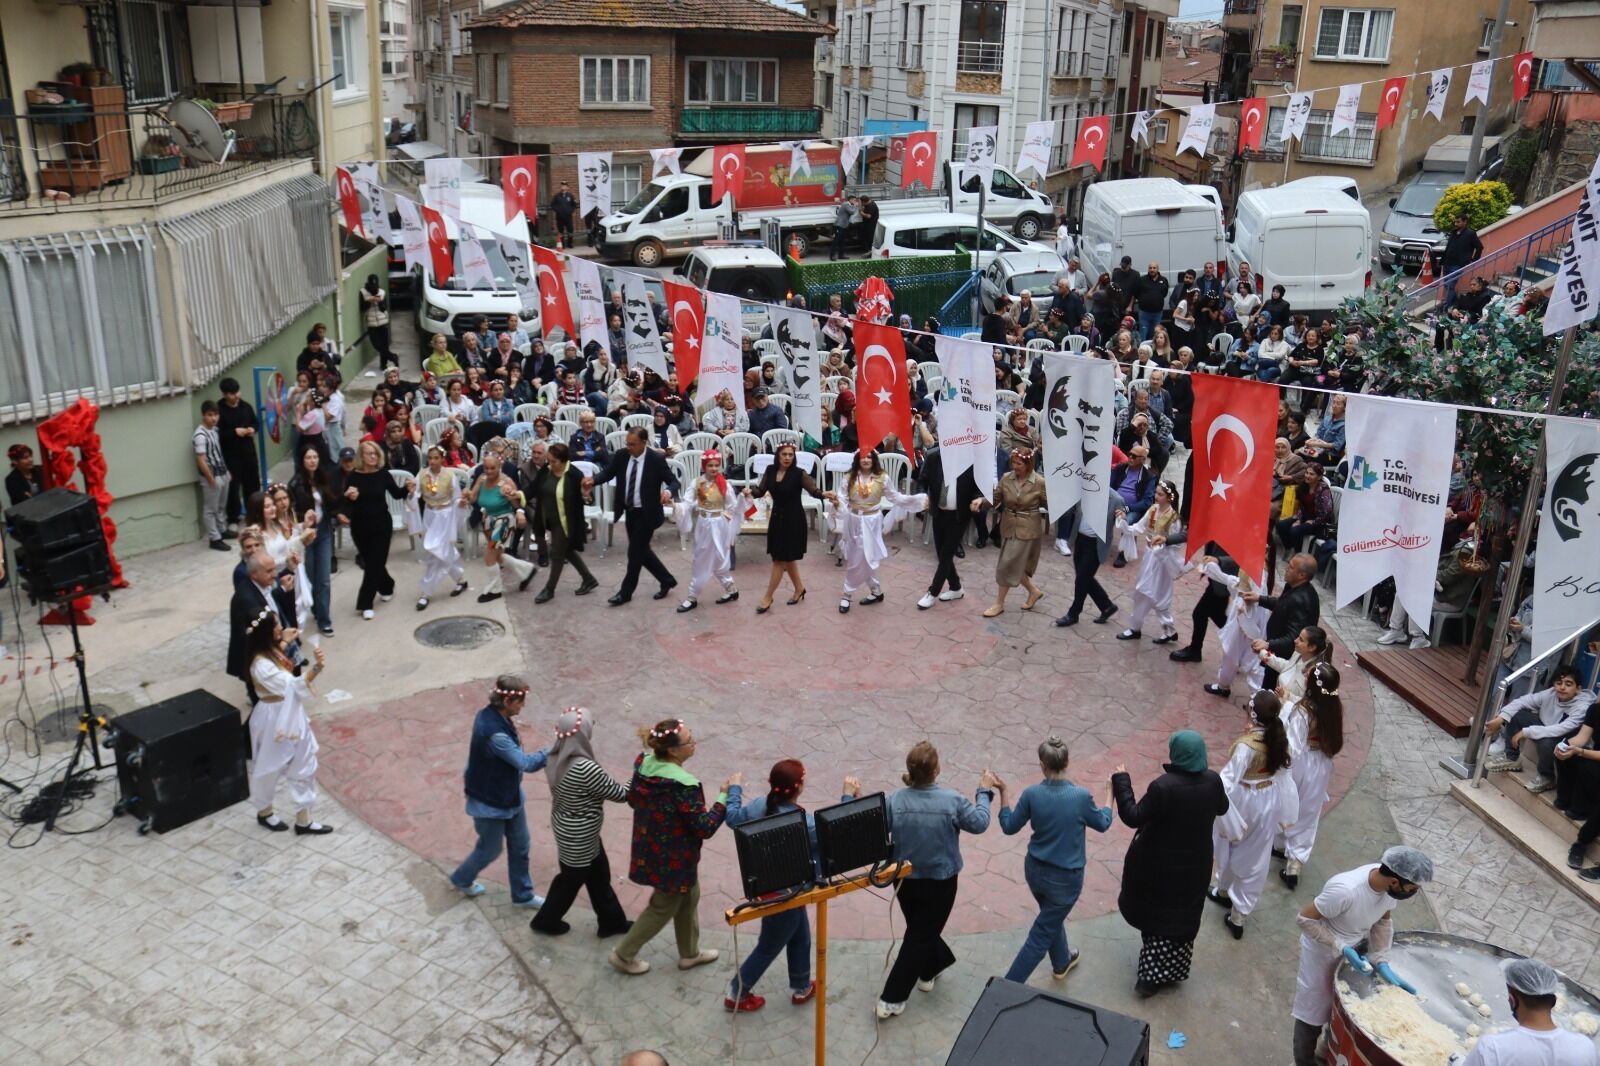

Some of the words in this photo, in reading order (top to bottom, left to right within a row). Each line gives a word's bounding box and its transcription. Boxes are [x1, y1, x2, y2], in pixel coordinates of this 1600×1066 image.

[1577, 187, 1598, 242] MİT
[1564, 238, 1590, 313] DİYESİ
[1383, 459, 1407, 470] T.C.
[1383, 469, 1413, 485] İZMİT
[1383, 484, 1441, 505] BELEDİYESİ
[1342, 538, 1388, 554] Gülümse
